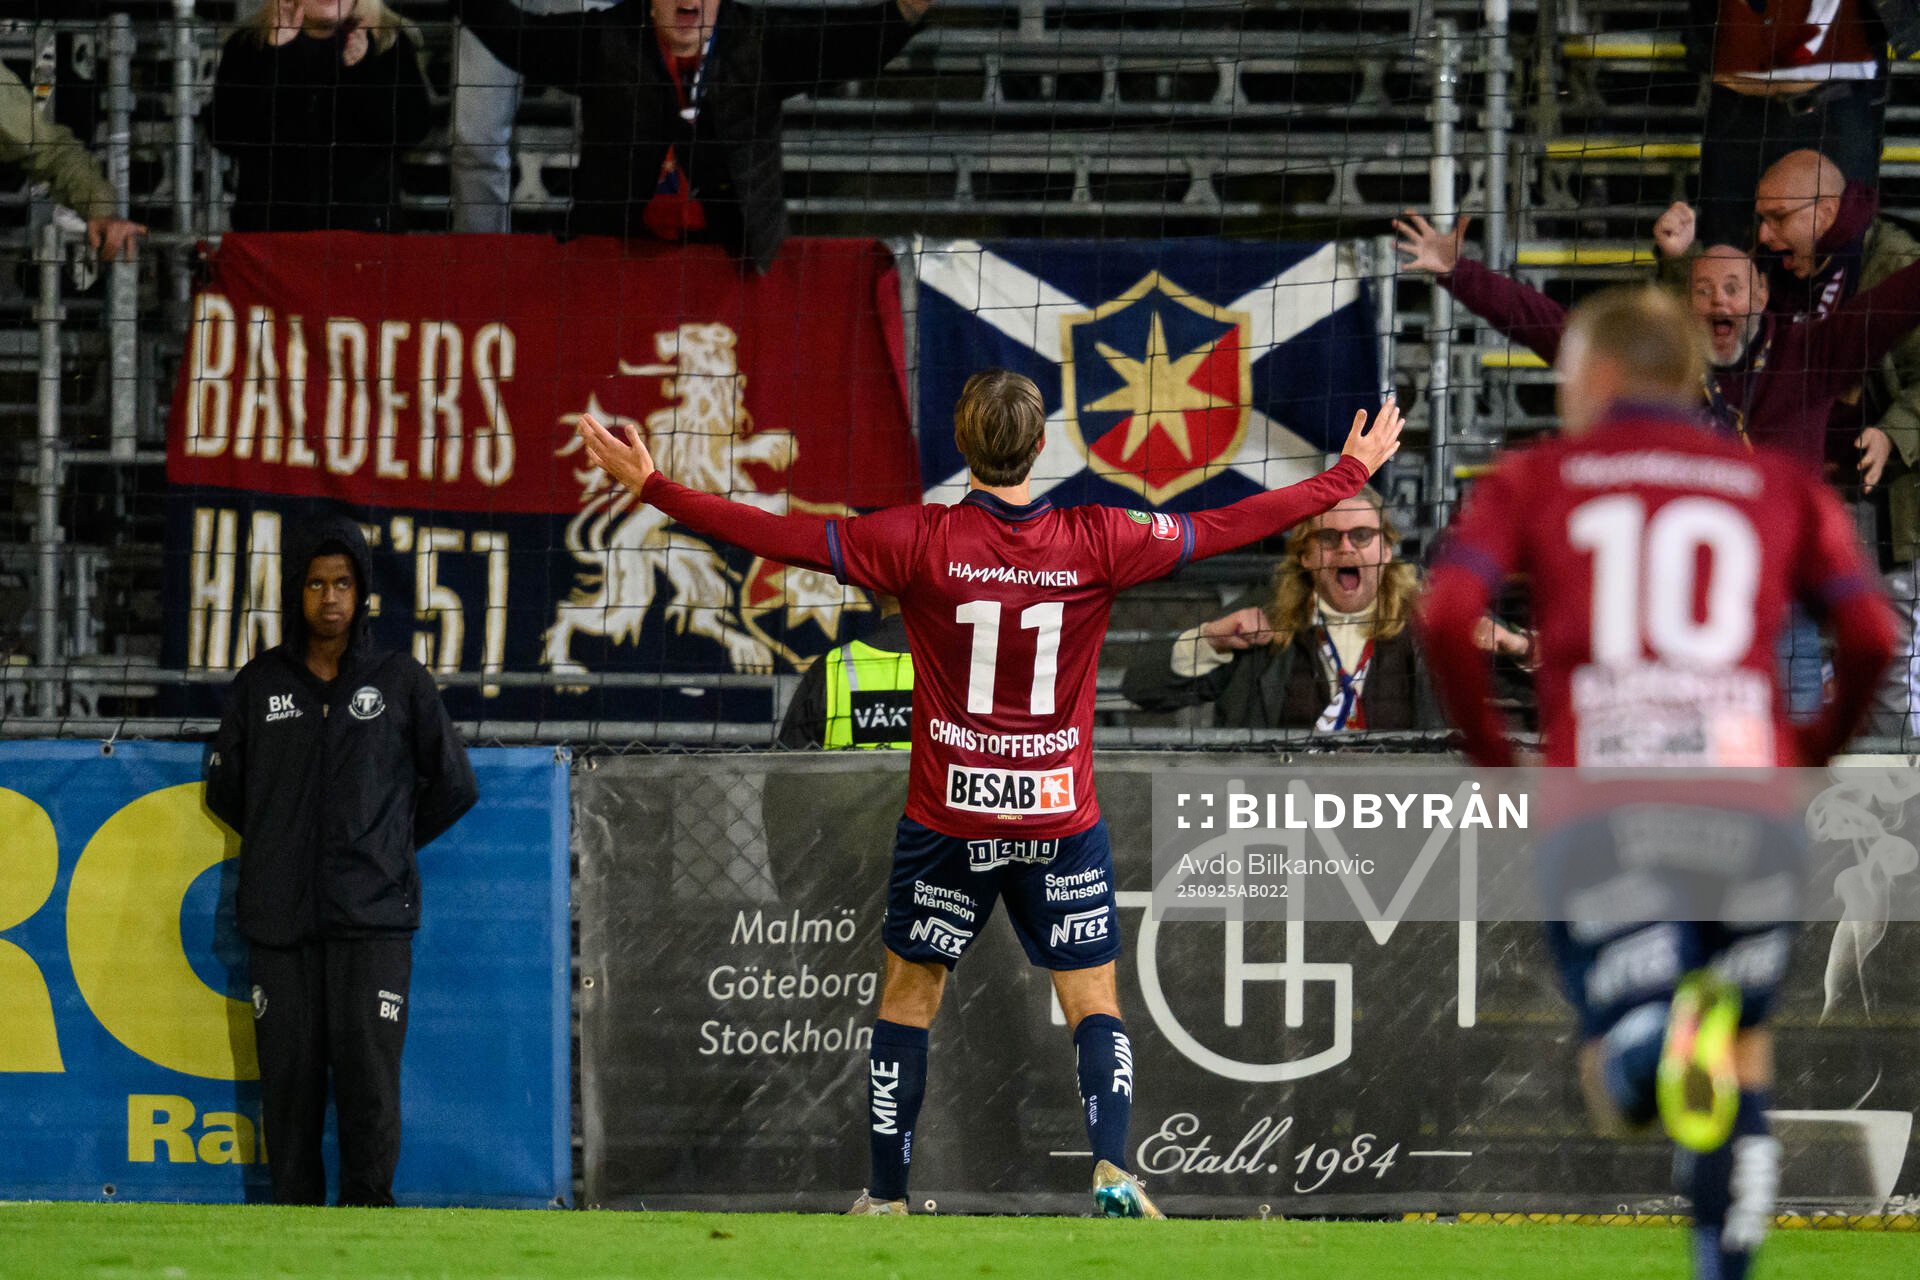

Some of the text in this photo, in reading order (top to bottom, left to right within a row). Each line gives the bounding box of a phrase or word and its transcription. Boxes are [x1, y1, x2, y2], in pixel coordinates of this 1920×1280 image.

[184, 294, 516, 487] BALDERS
[949, 561, 1078, 587] HAMMARVIKEN
[1567, 493, 1762, 671] 10
[956, 600, 1064, 716] 11
[269, 693, 295, 712] BK
[951, 770, 1036, 809] BESAB
[913, 892, 975, 922] Månsson
[1046, 881, 1108, 901] Månsson
[730, 909, 856, 945] Malmö
[708, 964, 878, 1005] Göteborg
[380, 1001, 400, 1022] BK
[1112, 1031, 1133, 1105] MIKE
[870, 1059, 899, 1135] MIKE
[1089, 1095, 1098, 1126] umbro
[903, 1131, 912, 1165] umbro
[1136, 1112, 1400, 1193] Etabl. 1984
